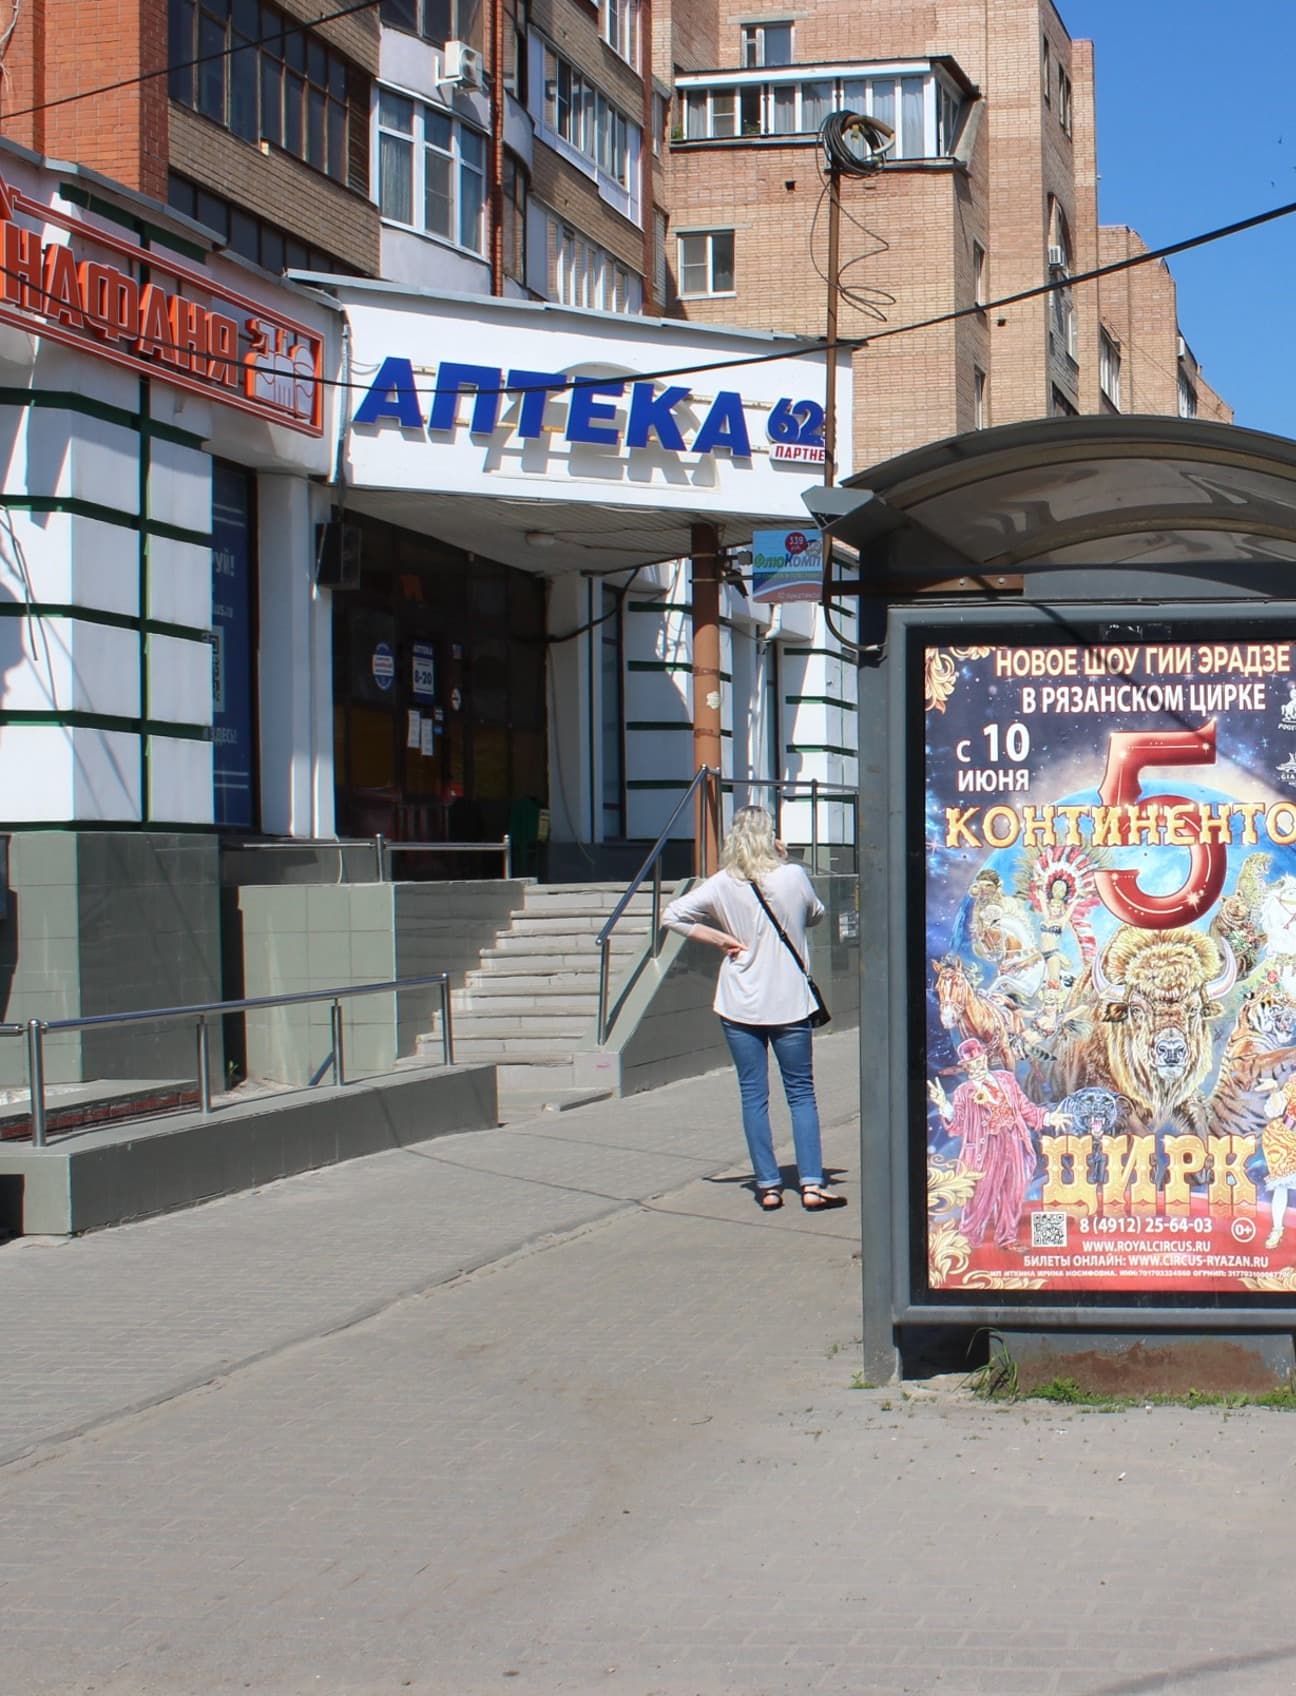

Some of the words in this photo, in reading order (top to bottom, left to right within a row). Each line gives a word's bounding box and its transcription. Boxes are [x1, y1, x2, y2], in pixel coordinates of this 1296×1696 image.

[0, 219, 240, 388] НАФАНЯ
[352, 356, 752, 457] АПТЕКА
[768, 398, 825, 447] 62
[775, 446, 826, 462] ПАРТНЕ
[996, 648, 1078, 677] НОВОЕ
[1084, 647, 1140, 675] ШОУ
[1145, 646, 1192, 674] ГИИ
[1198, 645, 1291, 678] ЭРАДЗЕ
[1022, 686, 1037, 714] В
[1042, 684, 1184, 713] РЯЗАНСКОМ
[1190, 683, 1266, 717] ЦИРКЕ
[983, 722, 1030, 762] 10
[958, 768, 1030, 792] ИЮНЯ
[1041, 1134, 1259, 1215] ЦИРК
[1079, 1217, 1090, 1233] 8
[1092, 1216, 1142, 1234] (4912)
[1145, 1217, 1213, 1233] 25-64-03
[1234, 1223, 1253, 1236] 0+
[1023, 1254, 1071, 1267] БИЛЕТЫ
[1073, 1252, 1127, 1267] ОНЛАЙН:
[1128, 1253, 1269, 1268] WWW.CIRCUS-RYAZAN.RU
[1082, 1240, 1211, 1252] WWW.ROYALCIRCUS.RU
